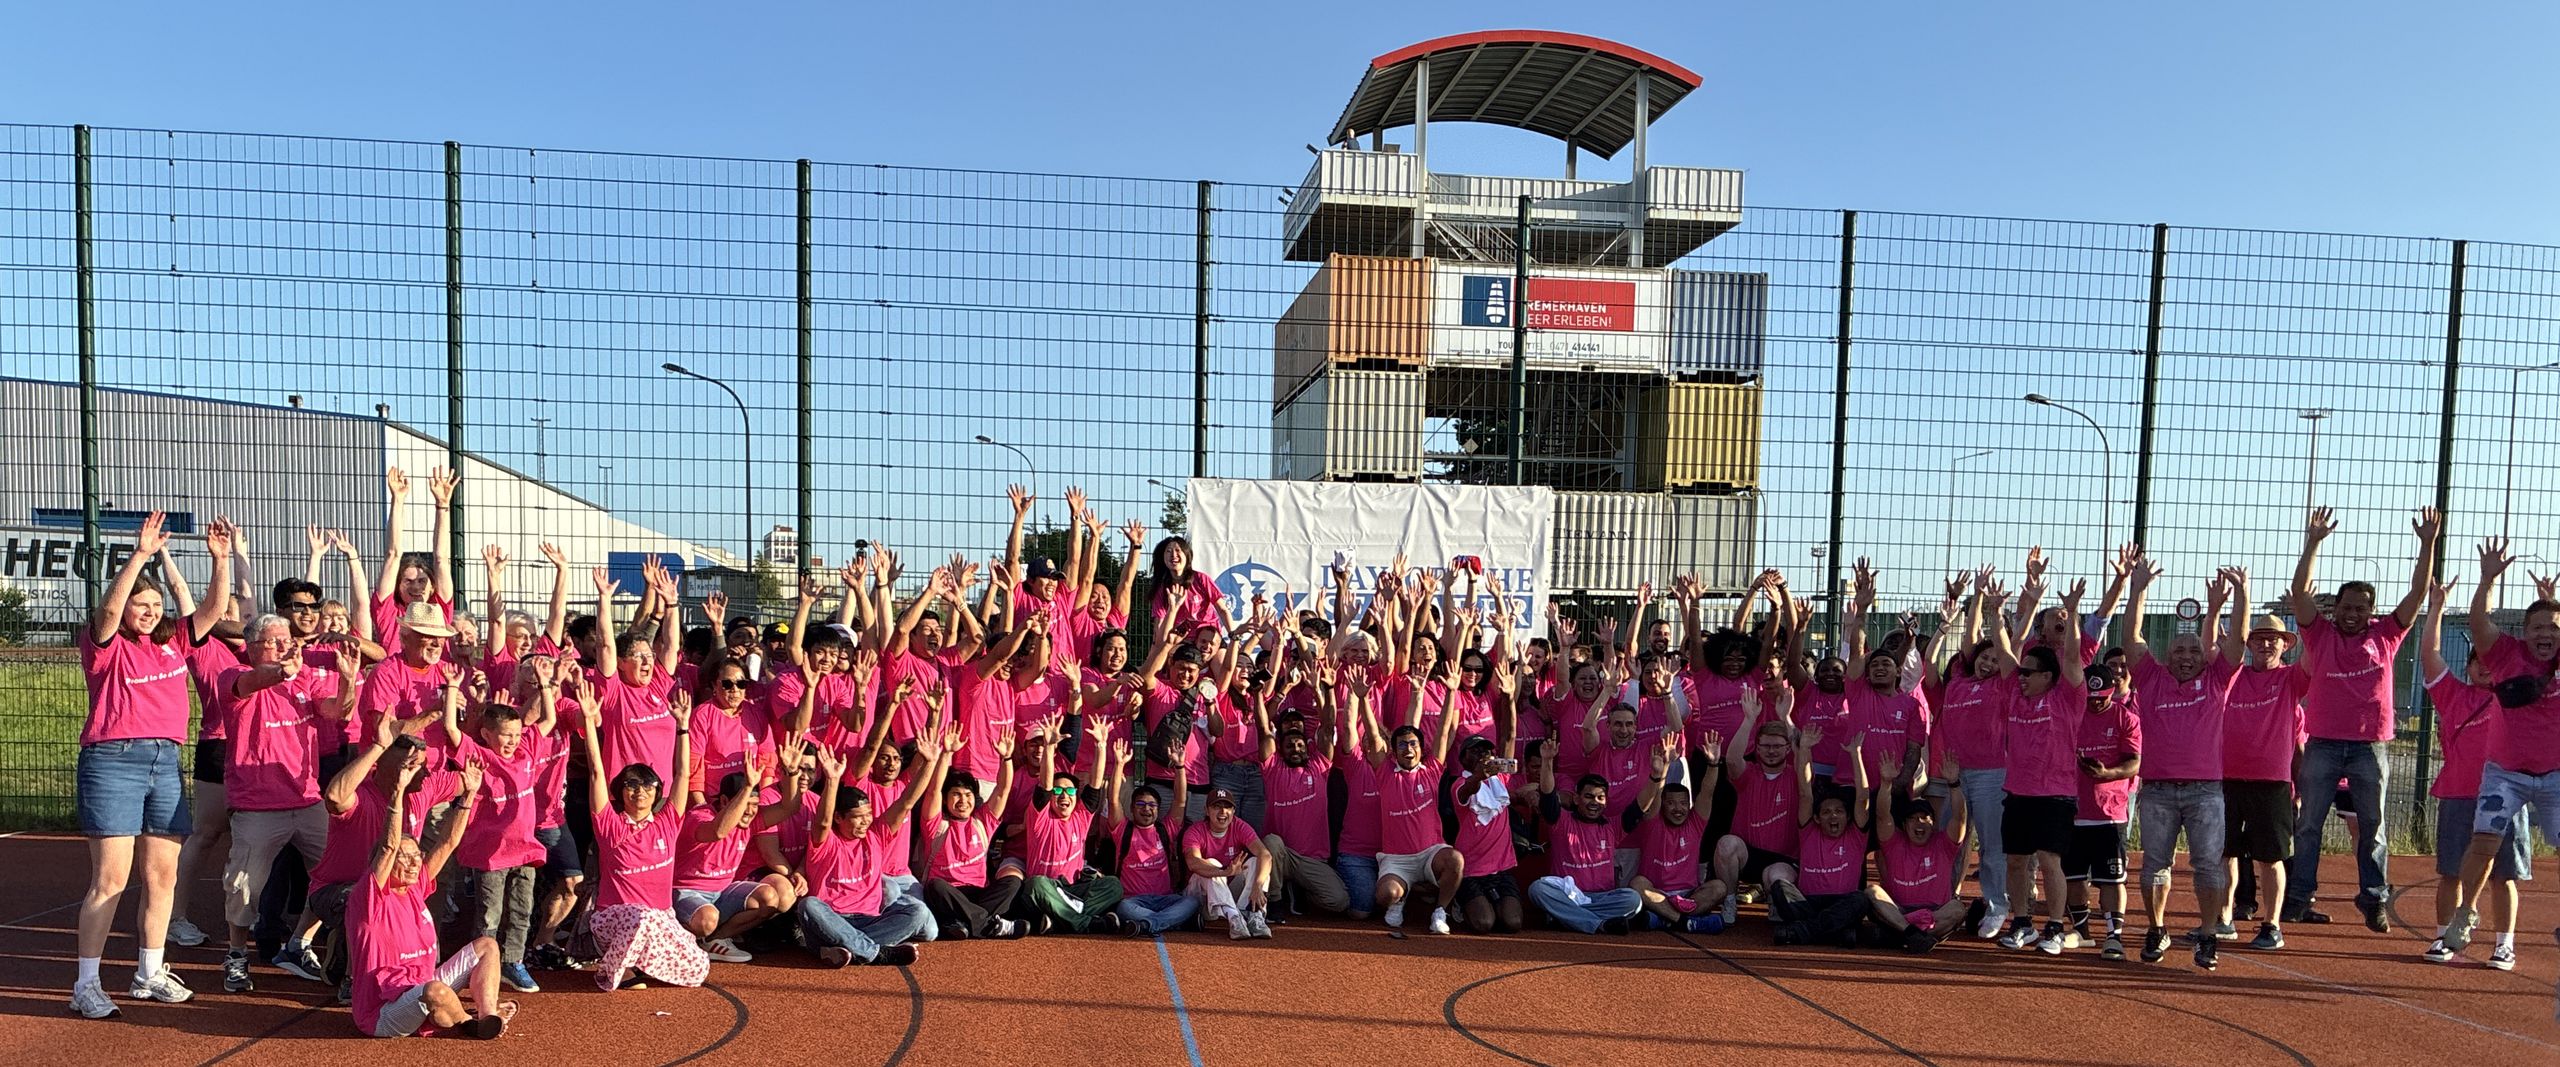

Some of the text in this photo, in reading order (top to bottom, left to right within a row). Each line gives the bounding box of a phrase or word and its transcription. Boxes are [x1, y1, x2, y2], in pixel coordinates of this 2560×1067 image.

[1527, 301, 1607, 313] REMERHAVEN
[1527, 313, 1612, 327] EER ERLEBEN!
[1572, 343, 1600, 352] 414141
